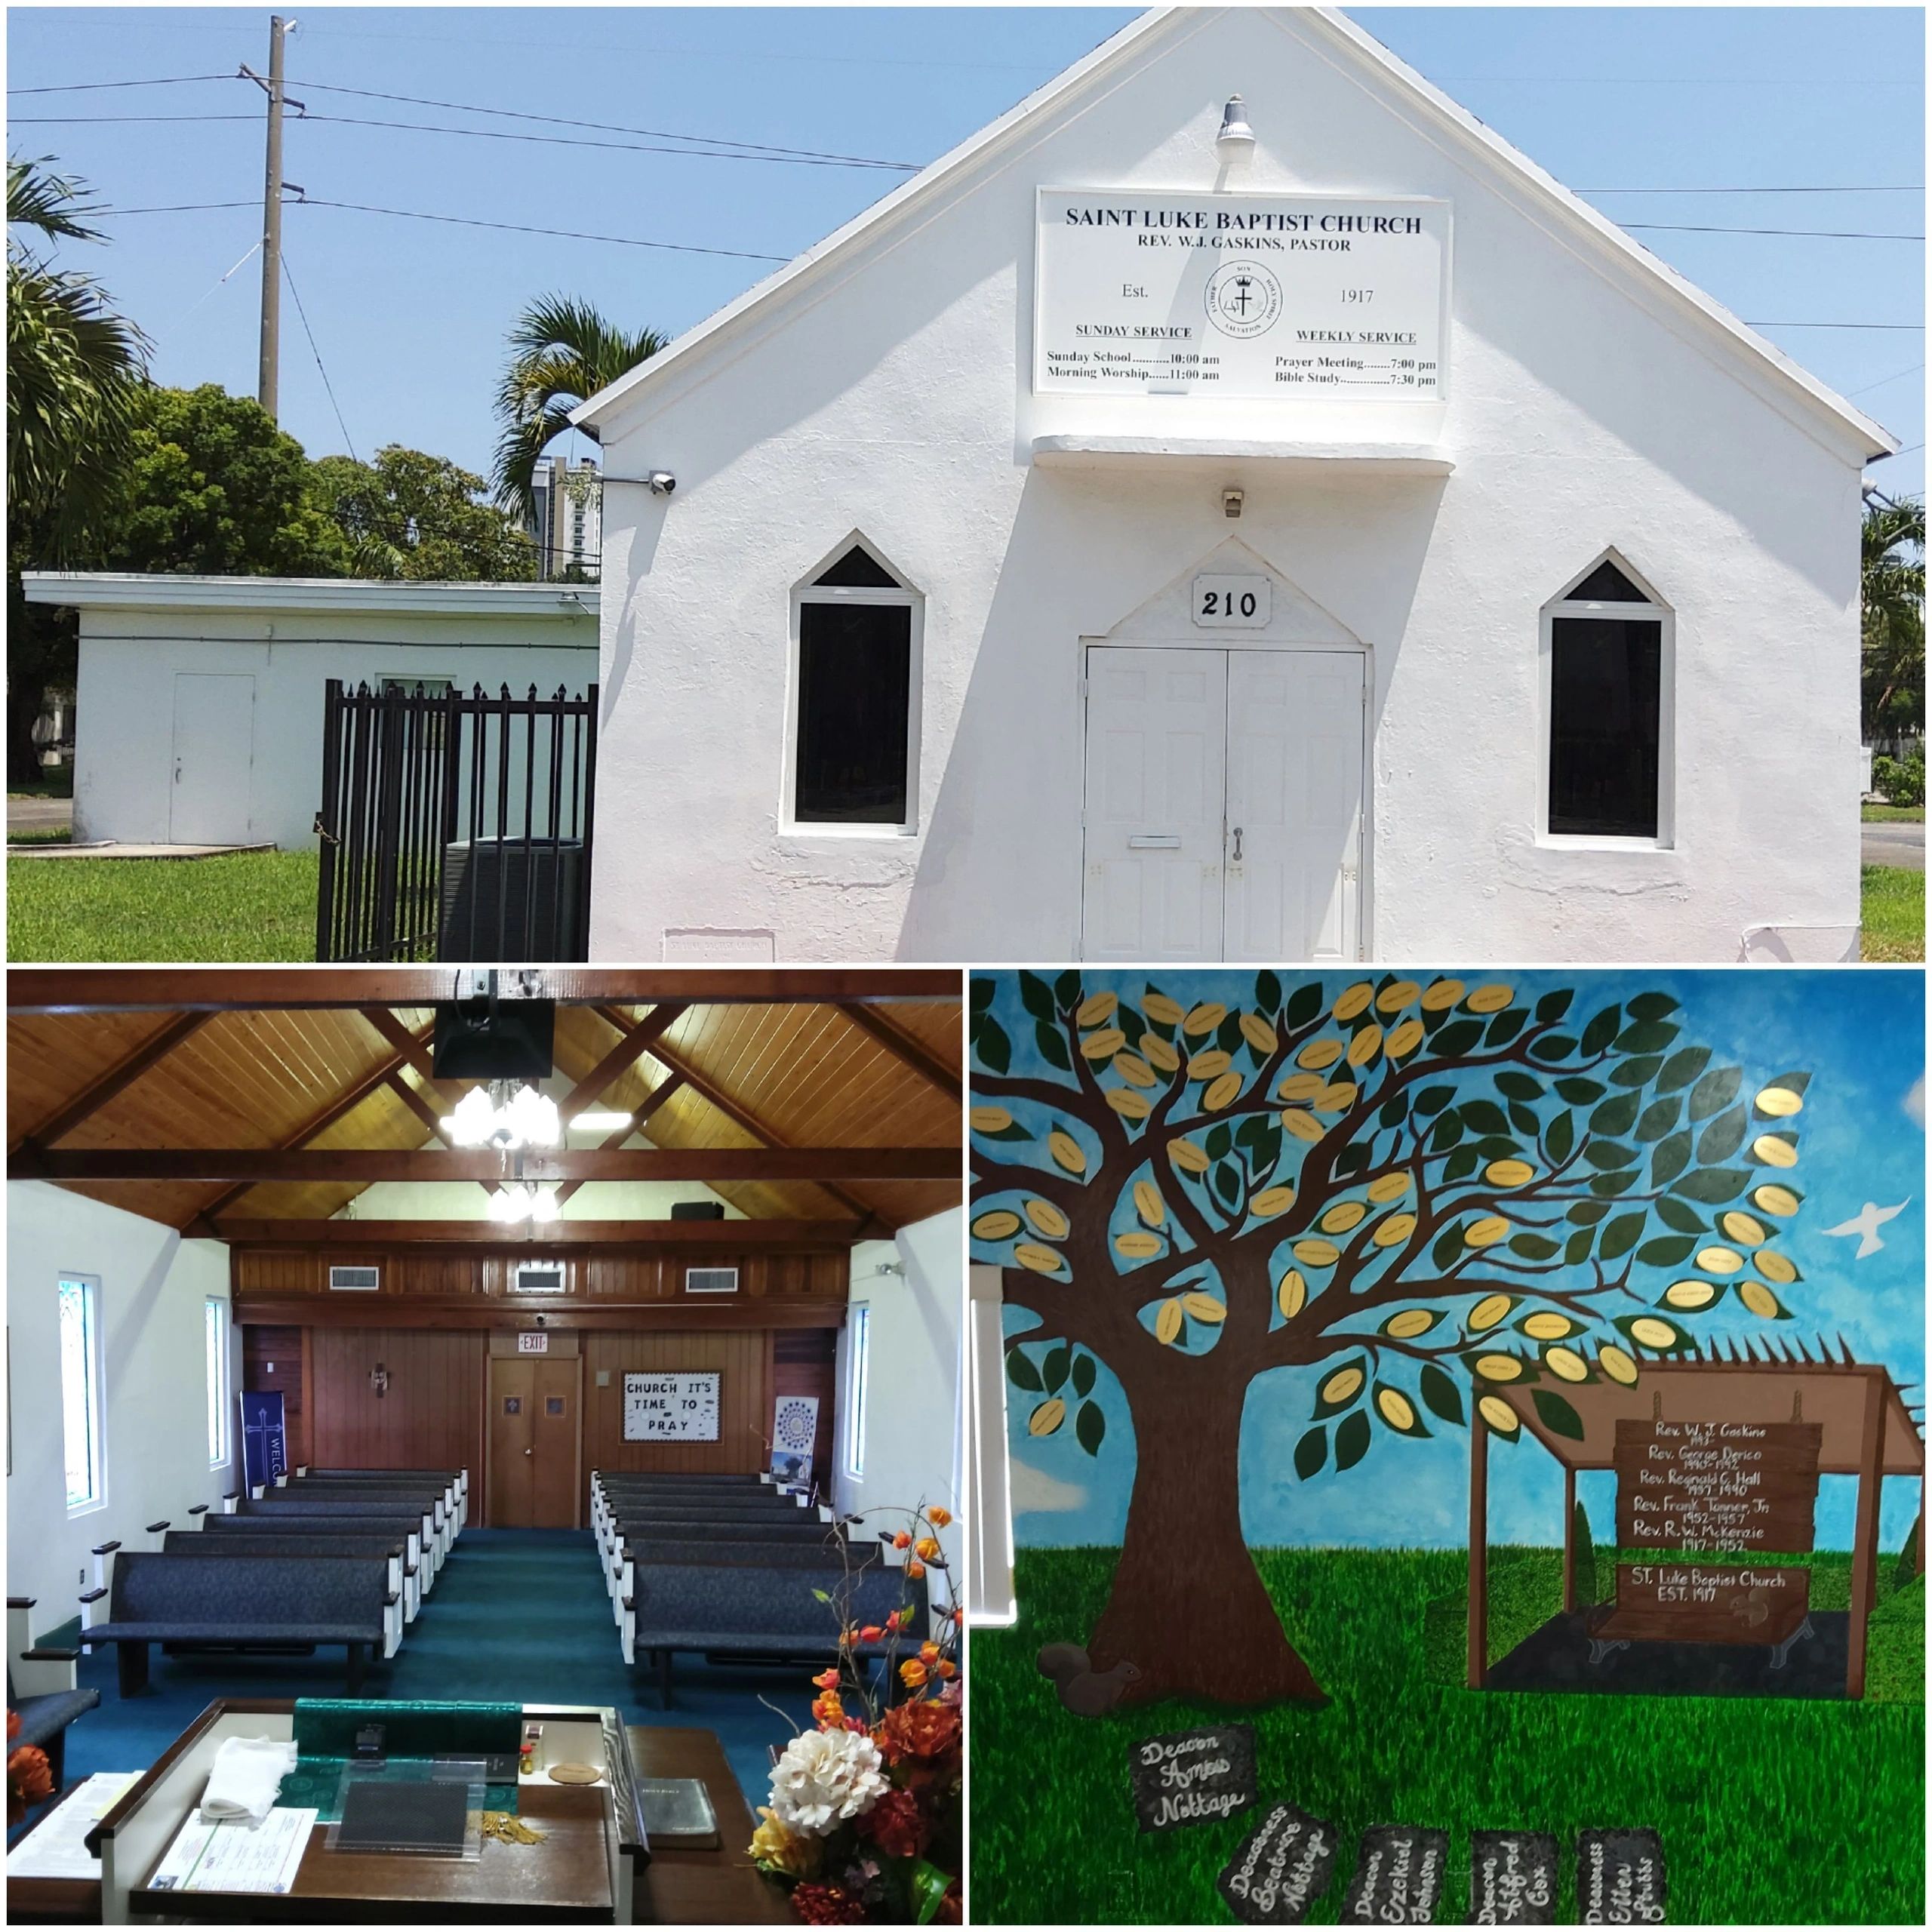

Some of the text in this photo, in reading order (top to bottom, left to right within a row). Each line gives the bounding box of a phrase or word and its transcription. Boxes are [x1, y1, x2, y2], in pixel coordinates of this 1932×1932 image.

[1066, 208, 1422, 234] SAINT LUKE BAPTIST CHURCH
[1138, 234, 1351, 251] REV. W.J. GASKINS, PASTOR
[1122, 284, 1149, 298] Est.
[1341, 290, 1374, 303] 1917
[1075, 325, 1192, 338] SUNDAY SERVICE
[1297, 330, 1417, 343] WEEKLY SERVICE
[1047, 351, 1090, 365] Sunday
[1201, 356, 1220, 365] am
[1275, 356, 1313, 369] Prayer
[1418, 361, 1436, 372] pm
[1047, 366, 1097, 378] Morning
[1201, 372, 1220, 380] am
[1275, 372, 1304, 383] Bible
[1418, 377, 1436, 388] pm
[1201, 592, 1256, 617] 210
[524, 1336, 543, 1349] EXIT
[627, 1382, 711, 1393] CHURCH IT'S
[634, 1399, 697, 1410] TIME TO
[648, 1420, 688, 1430] PRAY
[1656, 1421, 1681, 1437] Rev.
[1684, 1423, 1702, 1437] W.
[1720, 1423, 1767, 1438] Gaskins
[1648, 1444, 1762, 1463] Rev. George Derico
[1640, 1469, 1665, 1484] Rev.
[1668, 1469, 1718, 1488] Reginald
[1736, 1472, 1761, 1486] Hall
[1634, 1495, 1660, 1512] Rev.
[1663, 1494, 1698, 1512] Frank
[1633, 1519, 1764, 1539] Rev. R. W. McKenzie
[1632, 1566, 1786, 1589] ST. Luke Baptist Church
[1657, 1586, 1717, 1603] EST. 1917
[1140, 1736, 1220, 1766] Deacon
[1153, 1792, 1245, 1826] Nottage
[1229, 1805, 1288, 1900] Deaconess
[1251, 1822, 1302, 1912] Beatrice
[1282, 1829, 1331, 1912] Nottage
[1355, 1850, 1383, 1921] Deacon
[1380, 1838, 1413, 1924] Ezekiel
[1410, 1848, 1438, 1923] Johnson
[1497, 1840, 1527, 1921] Alfred
[1525, 1866, 1549, 1907] Cox
[1586, 1842, 1604, 1925] Deaconess
[1477, 1857, 1497, 1925] Deacon
